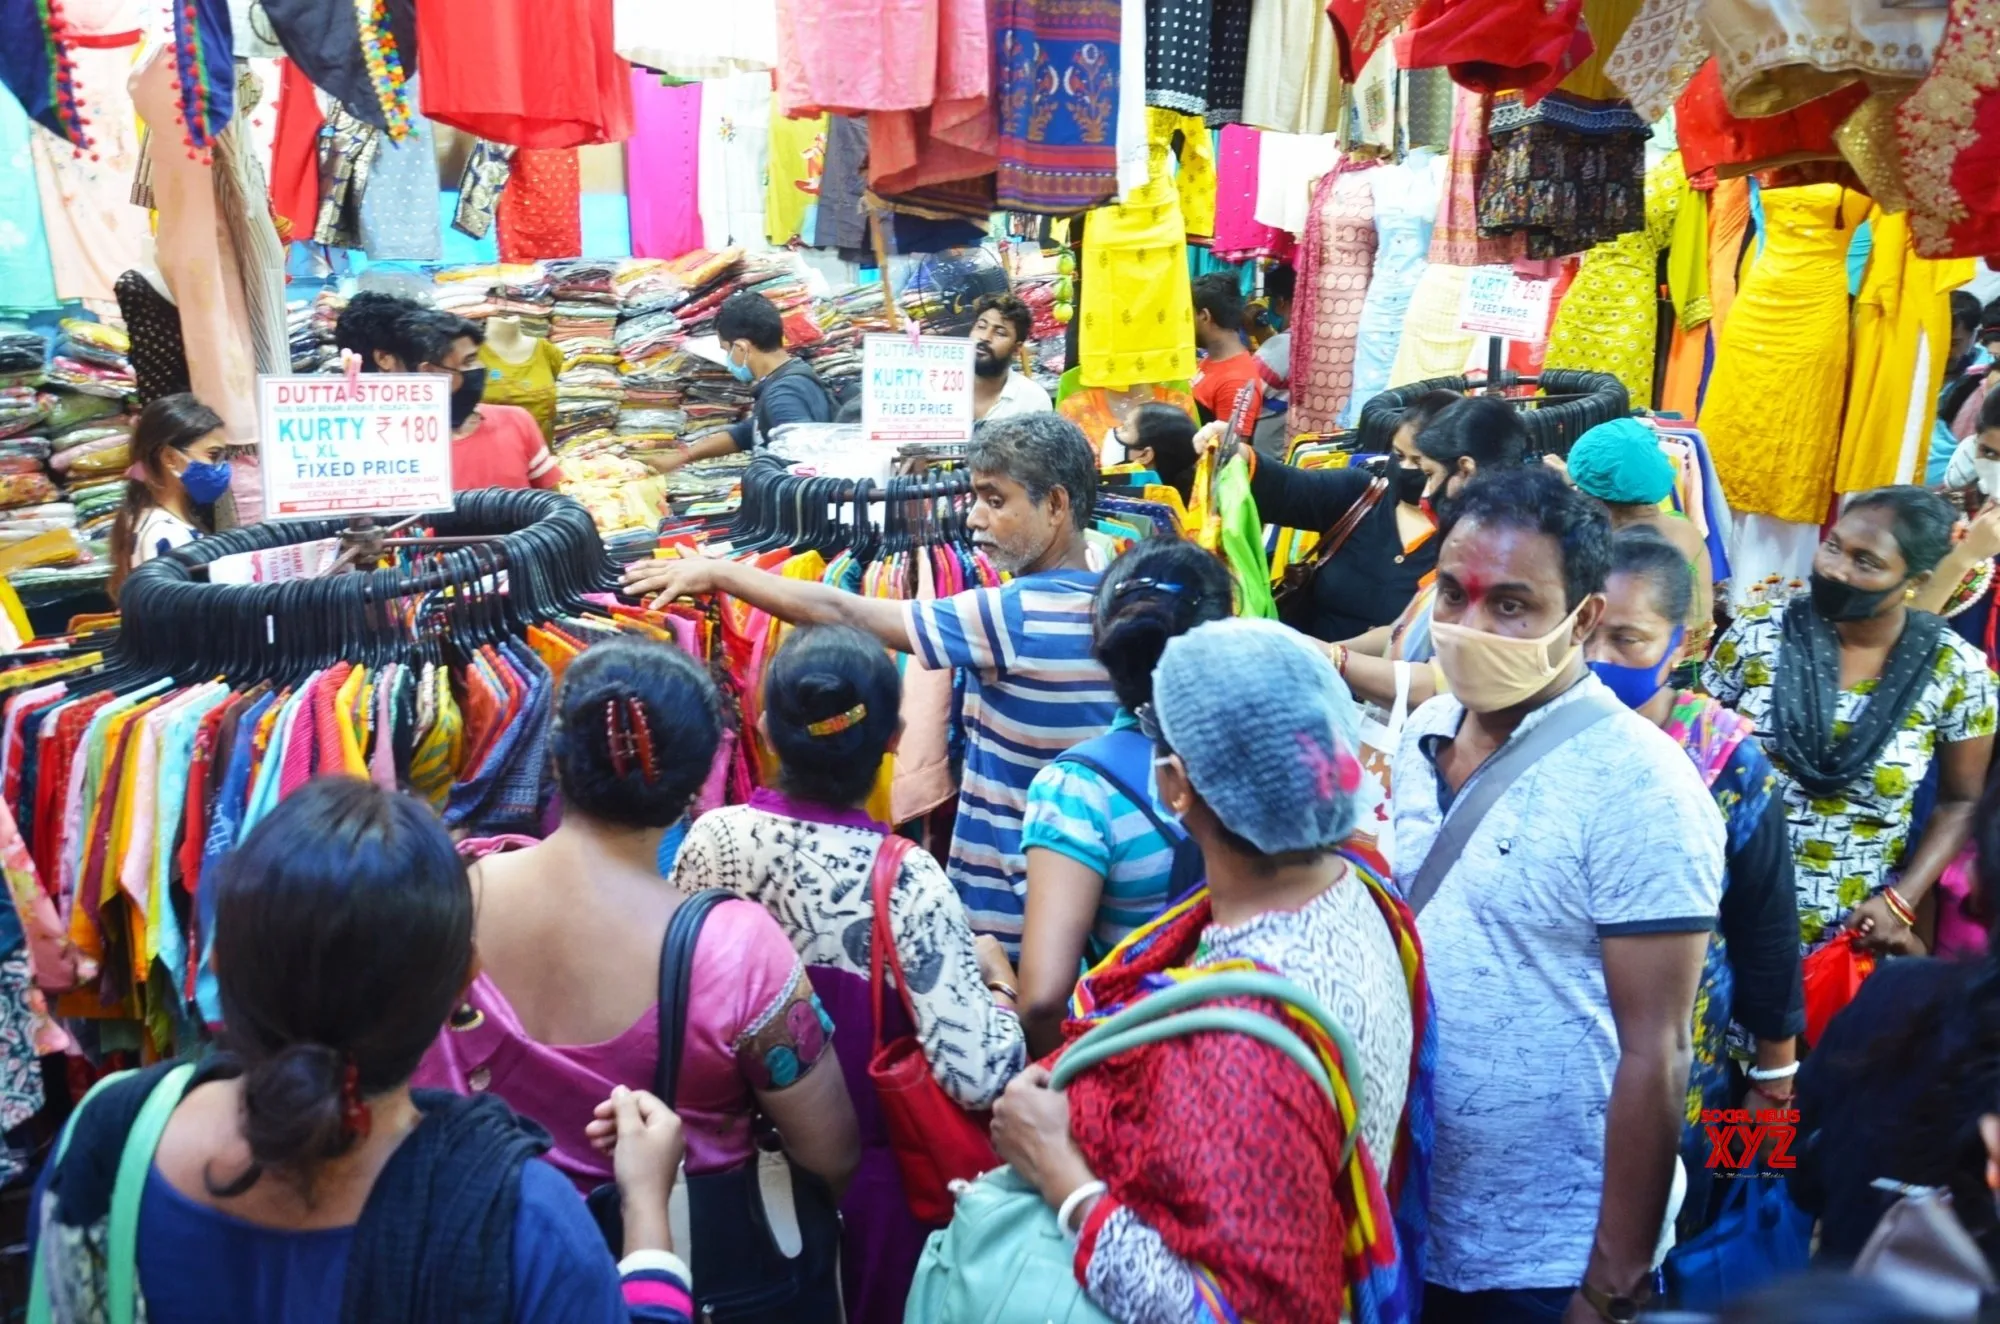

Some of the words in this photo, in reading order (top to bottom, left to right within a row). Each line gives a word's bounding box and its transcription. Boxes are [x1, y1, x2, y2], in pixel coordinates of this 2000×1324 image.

[873, 368, 923, 387] KURTY
[278, 386, 346, 404] DUTTA
[355, 384, 433, 403] STORES
[882, 403, 916, 415] FIXED
[920, 403, 953, 415] PRICE
[279, 416, 365, 442] KURTY
[401, 415, 438, 444] 180
[316, 443, 339, 458] XL
[297, 462, 355, 478] FIXED
[364, 459, 420, 476] PRICE
